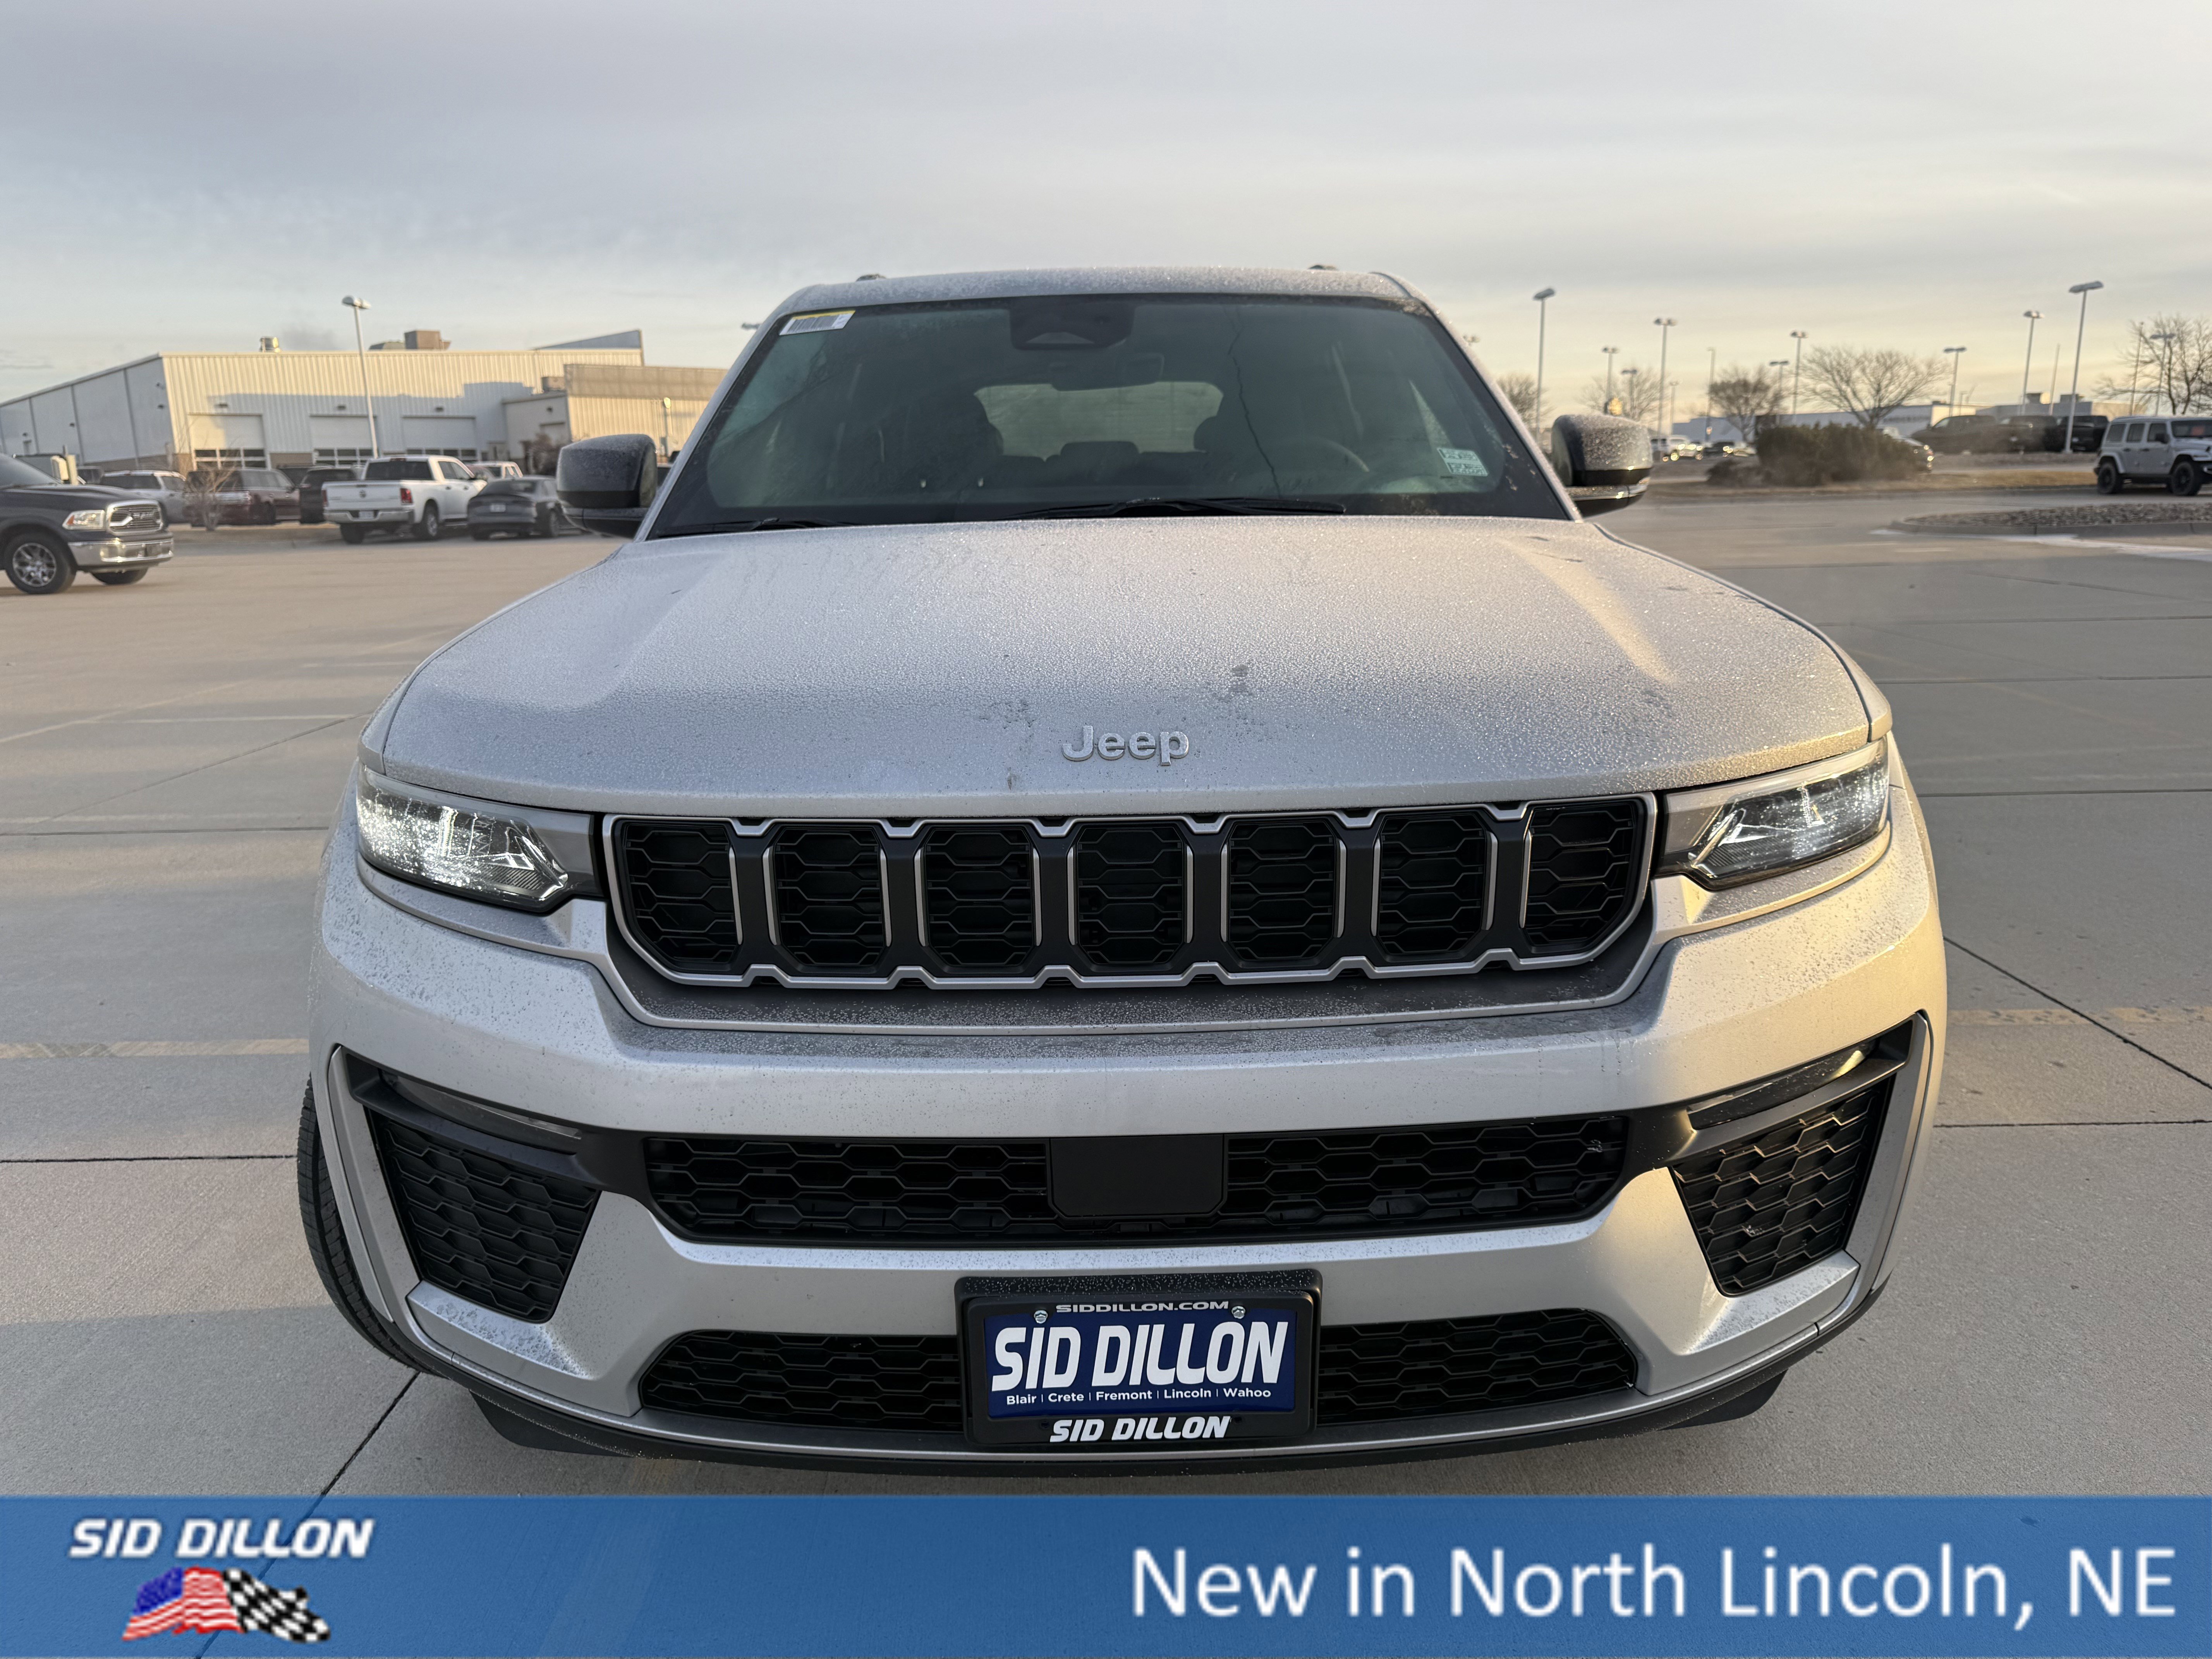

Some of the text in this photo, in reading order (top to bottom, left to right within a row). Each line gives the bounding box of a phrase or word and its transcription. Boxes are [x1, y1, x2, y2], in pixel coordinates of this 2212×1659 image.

[1062, 725, 1189, 765] Jeep
[1056, 1301, 1229, 1313] SIDDILLON.COM
[991, 1321, 1288, 1391] SID DILLON
[1006, 1388, 1271, 1405] Blair Crete Fremont Lincoln Wahoo
[1049, 1416, 1231, 1443] SID DILLON
